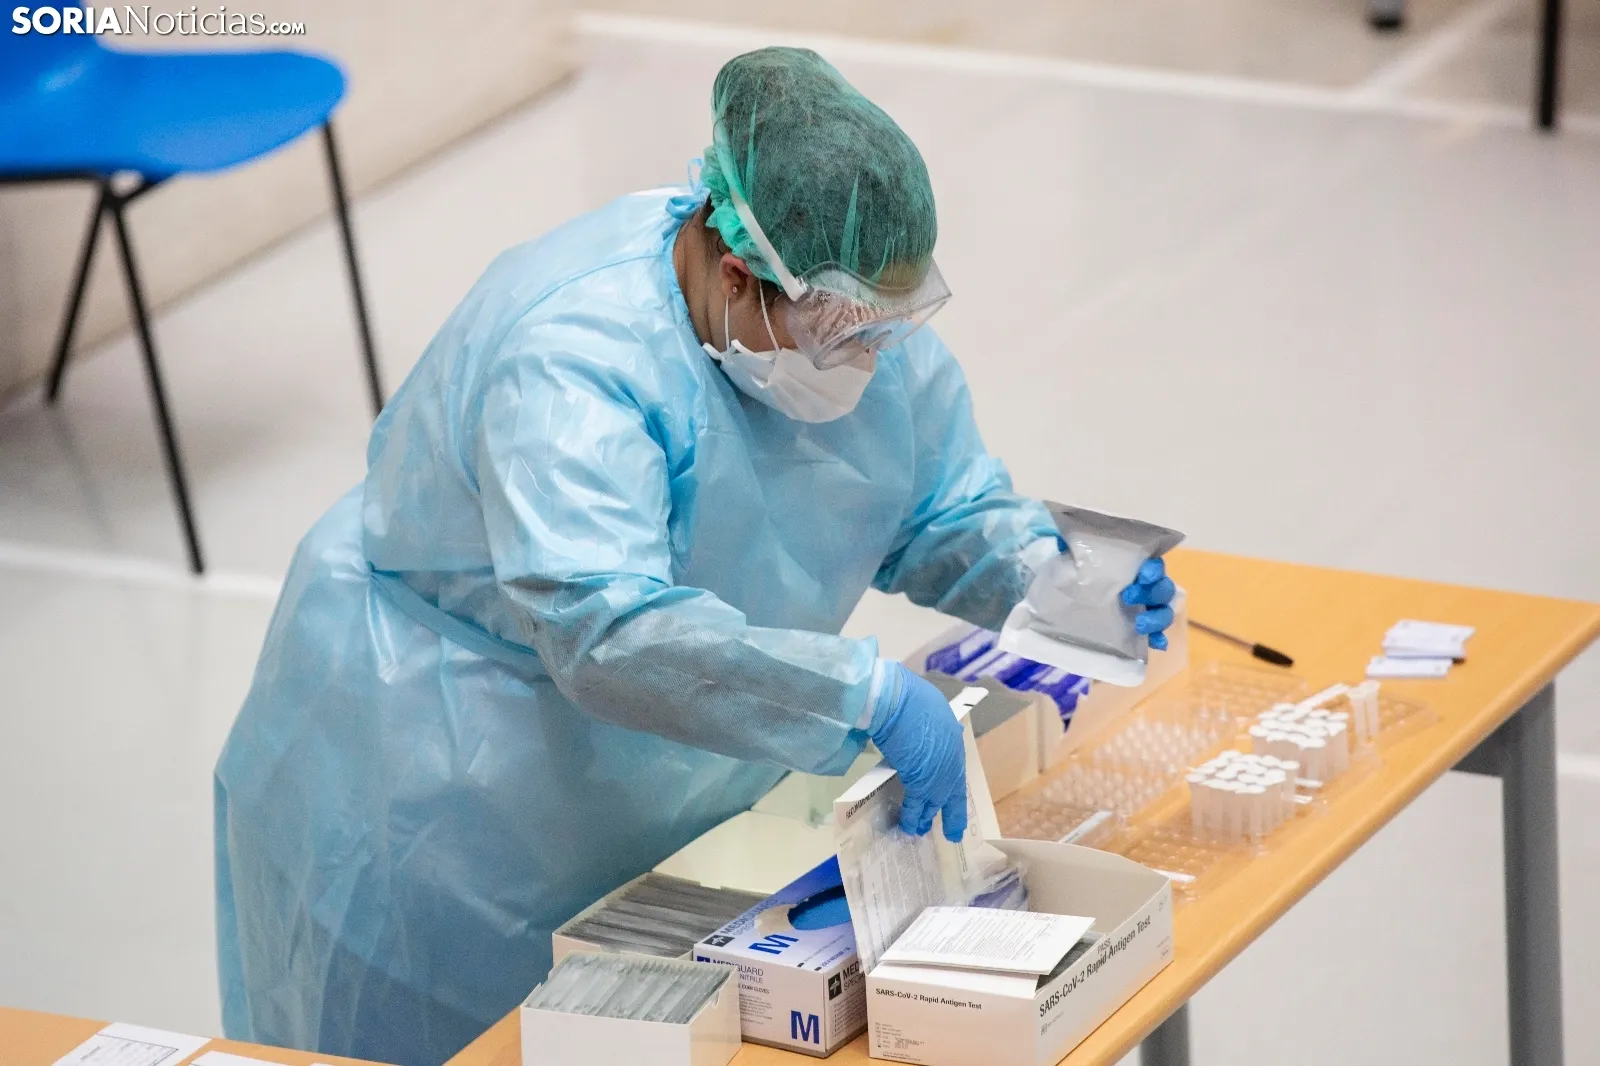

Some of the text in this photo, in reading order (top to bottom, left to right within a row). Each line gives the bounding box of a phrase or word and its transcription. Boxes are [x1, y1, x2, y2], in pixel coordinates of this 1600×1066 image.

[748, 934, 799, 955] M
[842, 960, 860, 980] MED
[1039, 971, 1085, 1018] SARS-CoV-2
[1086, 951, 1107, 978] Rapid
[1108, 929, 1136, 959] Antigen
[1137, 915, 1151, 934] Test
[739, 973, 763, 984] NITRILE
[875, 988, 982, 1009] SARS-CoV-2 Rapid Antigen Test
[791, 1010, 819, 1044] M
